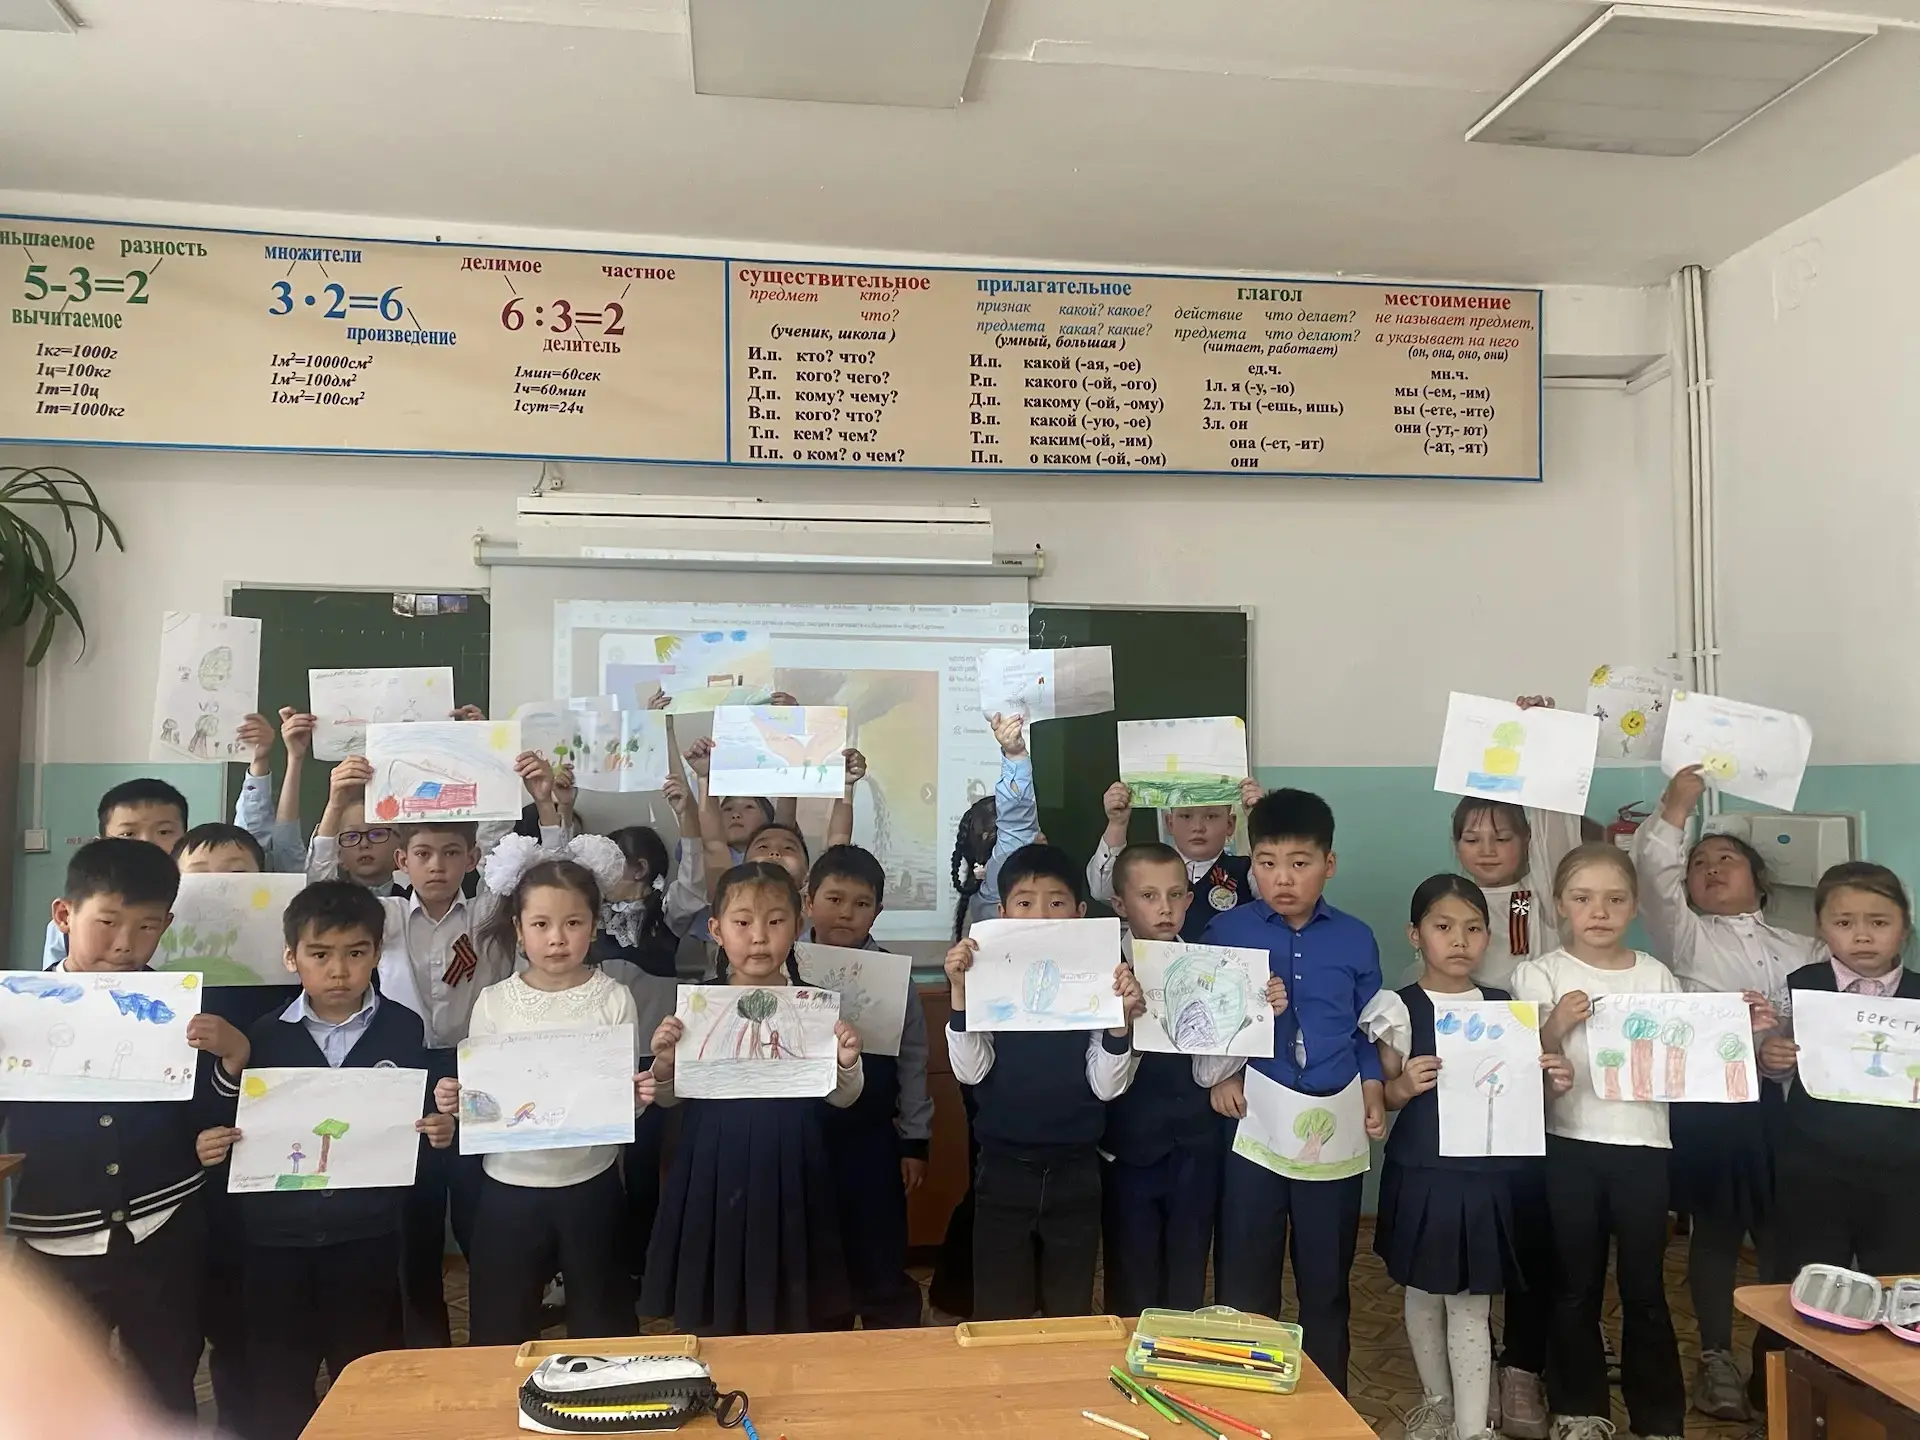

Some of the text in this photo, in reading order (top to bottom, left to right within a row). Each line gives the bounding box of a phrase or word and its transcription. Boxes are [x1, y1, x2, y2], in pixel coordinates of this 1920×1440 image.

[120, 240, 207, 258] разность
[265, 246, 362, 264] множители
[461, 257, 542, 273] делимое
[601, 266, 675, 280] частное
[738, 270, 930, 291] существительное
[977, 280, 1131, 296] прилагательное
[749, 289, 899, 303] предмет кто?
[1238, 288, 1302, 302] глагол
[1385, 294, 1511, 310] местоимение
[860, 309, 899, 322] что?
[977, 302, 1152, 316] признак какой? какое?
[1175, 306, 1356, 323] действие что делает?
[12, 308, 122, 328] вычитаемое
[1376, 314, 1534, 331] не называет предмет,
[347, 326, 456, 346] произведение
[770, 324, 833, 341] (ученик,
[977, 319, 1152, 336] предмета какая? какие?
[1175, 326, 1360, 342] предмета что делают?
[543, 338, 620, 353] делитель
[995, 336, 1051, 350] (умный,
[1203, 340, 1337, 358] (читает, работает)
[1376, 334, 1519, 347] а указывает на него
[36, 343, 118, 359] 1кг=1000г
[748, 347, 875, 364] И.п. кто? что?
[1409, 345, 1508, 362] (он, она, оно, они)
[36, 363, 111, 379] 1ц=100кг
[970, 354, 1142, 374] И.п. какой (-ая, -ое)
[1248, 364, 1281, 376] ед.ч.
[514, 366, 600, 381] 1мин=60сек
[748, 365, 890, 384] Р.п. кого? чего?
[1430, 371, 1468, 380] мн.ч.
[36, 382, 99, 399] 1т=10ц
[514, 381, 586, 397] 1ч=60мин
[970, 373, 1158, 393] Р.п. какого (-ой, -ого)
[1206, 379, 1295, 396] 1л. я (-у, -ю)
[746, 386, 898, 407] Д.п. кому? чему?
[1395, 385, 1490, 402] мы (-ем, -им)
[36, 401, 125, 417] 1т=1000кг
[514, 399, 583, 414] 1сут=24ч
[968, 393, 1165, 413] Д.п. какому (-ой, -ому)
[1203, 398, 1343, 416] 2л. ты (-ешь, ишь)
[748, 405, 882, 423] В.п. кого? что?
[1394, 403, 1494, 421] вы (-ете, -ите)
[970, 412, 1151, 431] В.п. какой (-ую, -ое)
[1203, 416, 1248, 430] 3л. он
[1395, 424, 1422, 433] они
[748, 426, 877, 442] Т.п. кем? чем?
[970, 431, 999, 444] Т.п.
[1119, 434, 1152, 450] -им)
[1230, 436, 1324, 452] она (-ет, -ит)
[1424, 440, 1488, 457] (-ат, -ят)
[749, 444, 906, 462] П.п. о ком? о чем?
[971, 450, 1167, 469] П.п. о каком (-ой, -ом)
[1231, 457, 1259, 469] они
